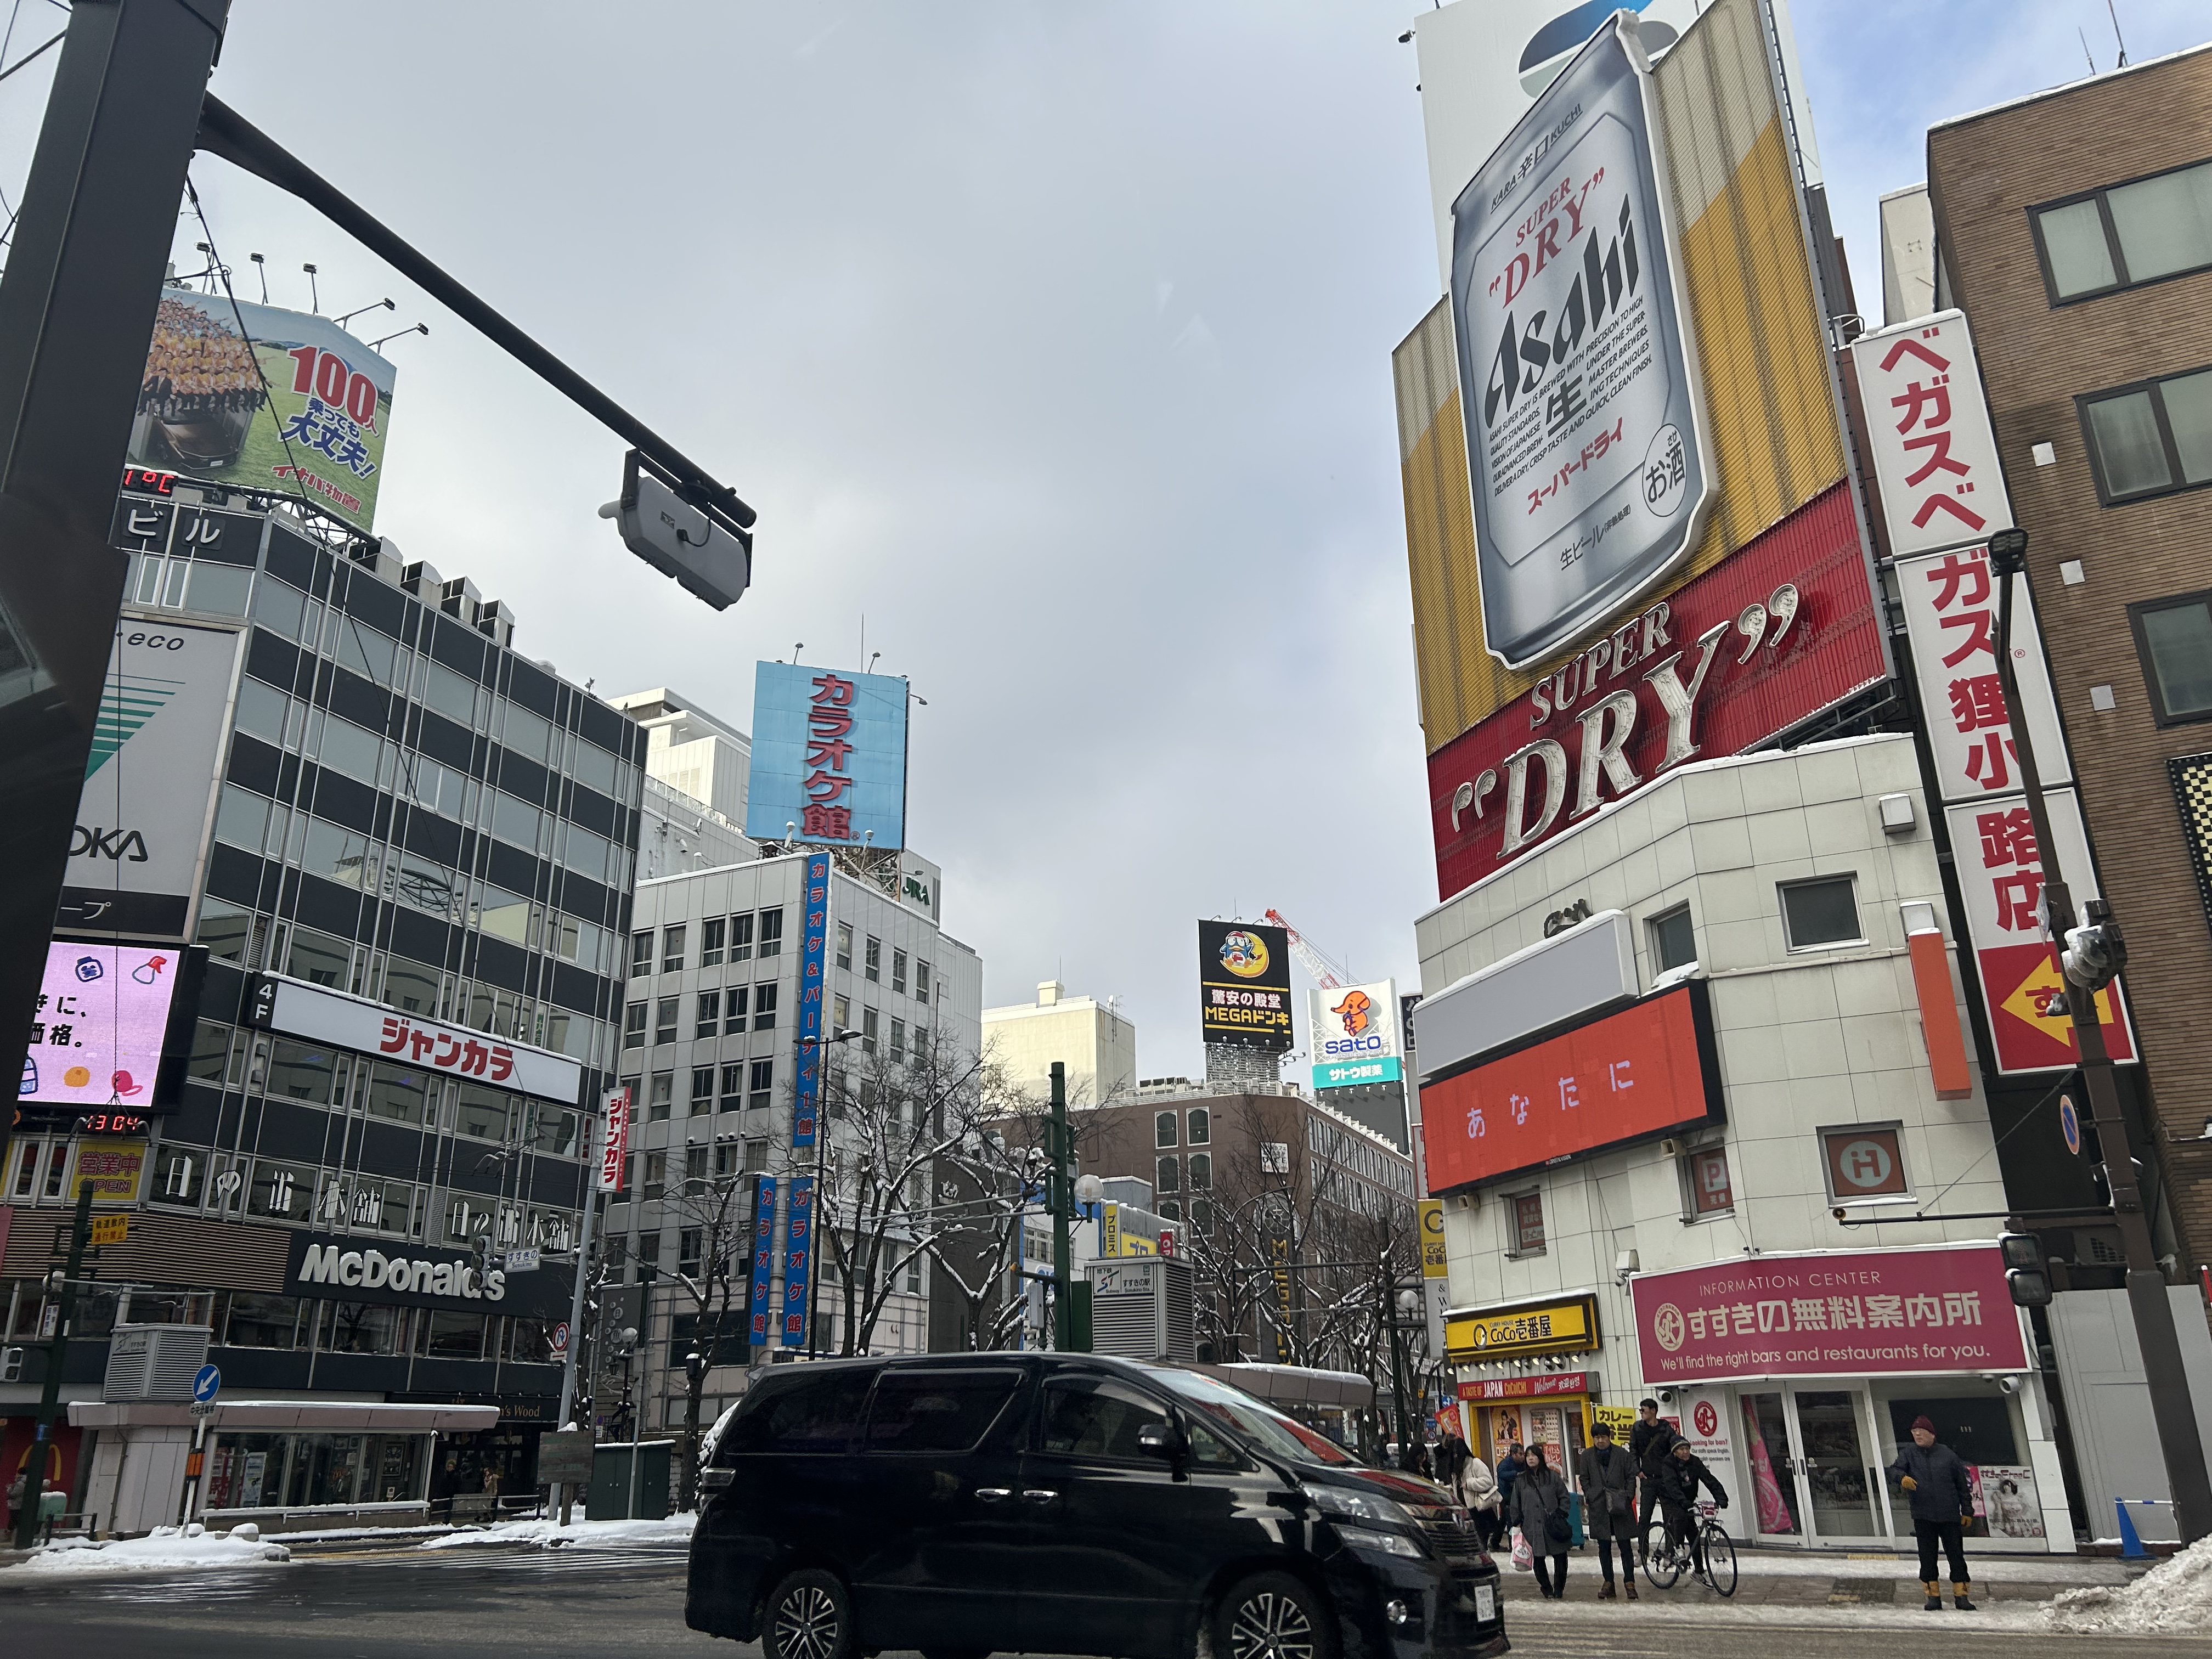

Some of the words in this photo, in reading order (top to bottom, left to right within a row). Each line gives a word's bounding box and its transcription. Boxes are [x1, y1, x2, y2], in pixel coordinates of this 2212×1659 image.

[1550, 103, 1583, 144] KUCHI
[1518, 135, 1549, 179] 辛口
[1491, 175, 1517, 211] KARA
[1516, 177, 1571, 248] SUPER
[1485, 193, 1639, 428] Asahi
[1489, 426, 1502, 443] ASAHI
[1503, 413, 1519, 432] SUPER
[1519, 398, 1532, 418] DRY
[1532, 392, 1538, 405] IS
[1538, 368, 1566, 400] BREWED
[1567, 351, 1585, 374] WITH
[1585, 317, 1619, 356] PRECISION
[1621, 311, 1630, 326] TO
[1630, 295, 1644, 318] HIGH
[1490, 437, 1509, 456] QUALITY
[1586, 346, 1611, 371] UNDER
[1611, 332, 1626, 352] THE
[1492, 453, 1506, 470] VISION
[1505, 447, 1513, 461] OF
[1511, 421, 1541, 453] JAPANESE
[1588, 357, 1618, 386] MASTER
[1493, 469, 1502, 483] OUR
[1502, 452, 1526, 478] ADVANCED
[1590, 379, 1605, 400] ING
[1605, 339, 1650, 393] TECHNIQUES
[1546, 374, 1587, 437] 生
[308, 397, 361, 439] 乗っても
[1494, 476, 1514, 498] DELIVER
[1530, 447, 1547, 467] CRISP
[1548, 429, 1568, 454] TASTE
[1568, 415, 1585, 437] AND
[1610, 373, 1632, 398] CLEAN
[280, 411, 379, 479] 大丈夫!
[1527, 417, 1623, 516] スーパードライ
[1645, 442, 1686, 504] お酒
[272, 464, 363, 514] イナバ物置
[127, 508, 221, 544] ビル
[1530, 602, 1671, 730] SUPER
[802, 674, 854, 839] カラオケ館
[902, 876, 930, 906] JRA
[1205, 1006, 1289, 1026] MEGAドンキ
[1211, 989, 1282, 1009] 驚安の殿堂
[379, 1017, 514, 1081] ジャンカラ
[1325, 1035, 1381, 1054] sato
[1329, 1064, 1383, 1081] サトウ製薬
[603, 1096, 623, 1183] ジャンカラ
[78, 1152, 142, 1176] 営業中
[1706, 1162, 1721, 1188] P
[79, 1178, 132, 1193] PEN
[1709, 1192, 1726, 1205] 完備
[1108, 1214, 1116, 1253] プロミス
[507, 1250, 538, 1262] すすきの
[753, 1188, 772, 1333] カラオケ館
[786, 1189, 810, 1333] カラオケ館
[1123, 1278, 1150, 1287] すすきの駅
[1699, 1276, 1800, 1297] INFORMATION
[1809, 1271, 1881, 1287] CENTER
[1491, 1314, 1552, 1343] CoCo壱番屋
[1687, 1291, 1983, 1340] すすきの無料案内所
[1660, 1355, 1684, 1370] We'll
[1685, 1353, 1705, 1369] find
[1706, 1352, 1723, 1367] the
[1724, 1350, 1749, 1368] right
[1752, 1346, 1782, 1363] bars
[1785, 1346, 1820, 1362] and
[1824, 1344, 1920, 1361] restaurants
[1922, 1343, 1947, 1358] for
[1949, 1344, 1991, 1361] you.
[1483, 1381, 1504, 1398] JAPAN
[1534, 1376, 1557, 1395] Welcome
[514, 1404, 541, 1417] Wood
[1599, 1409, 1633, 1422] カレー
